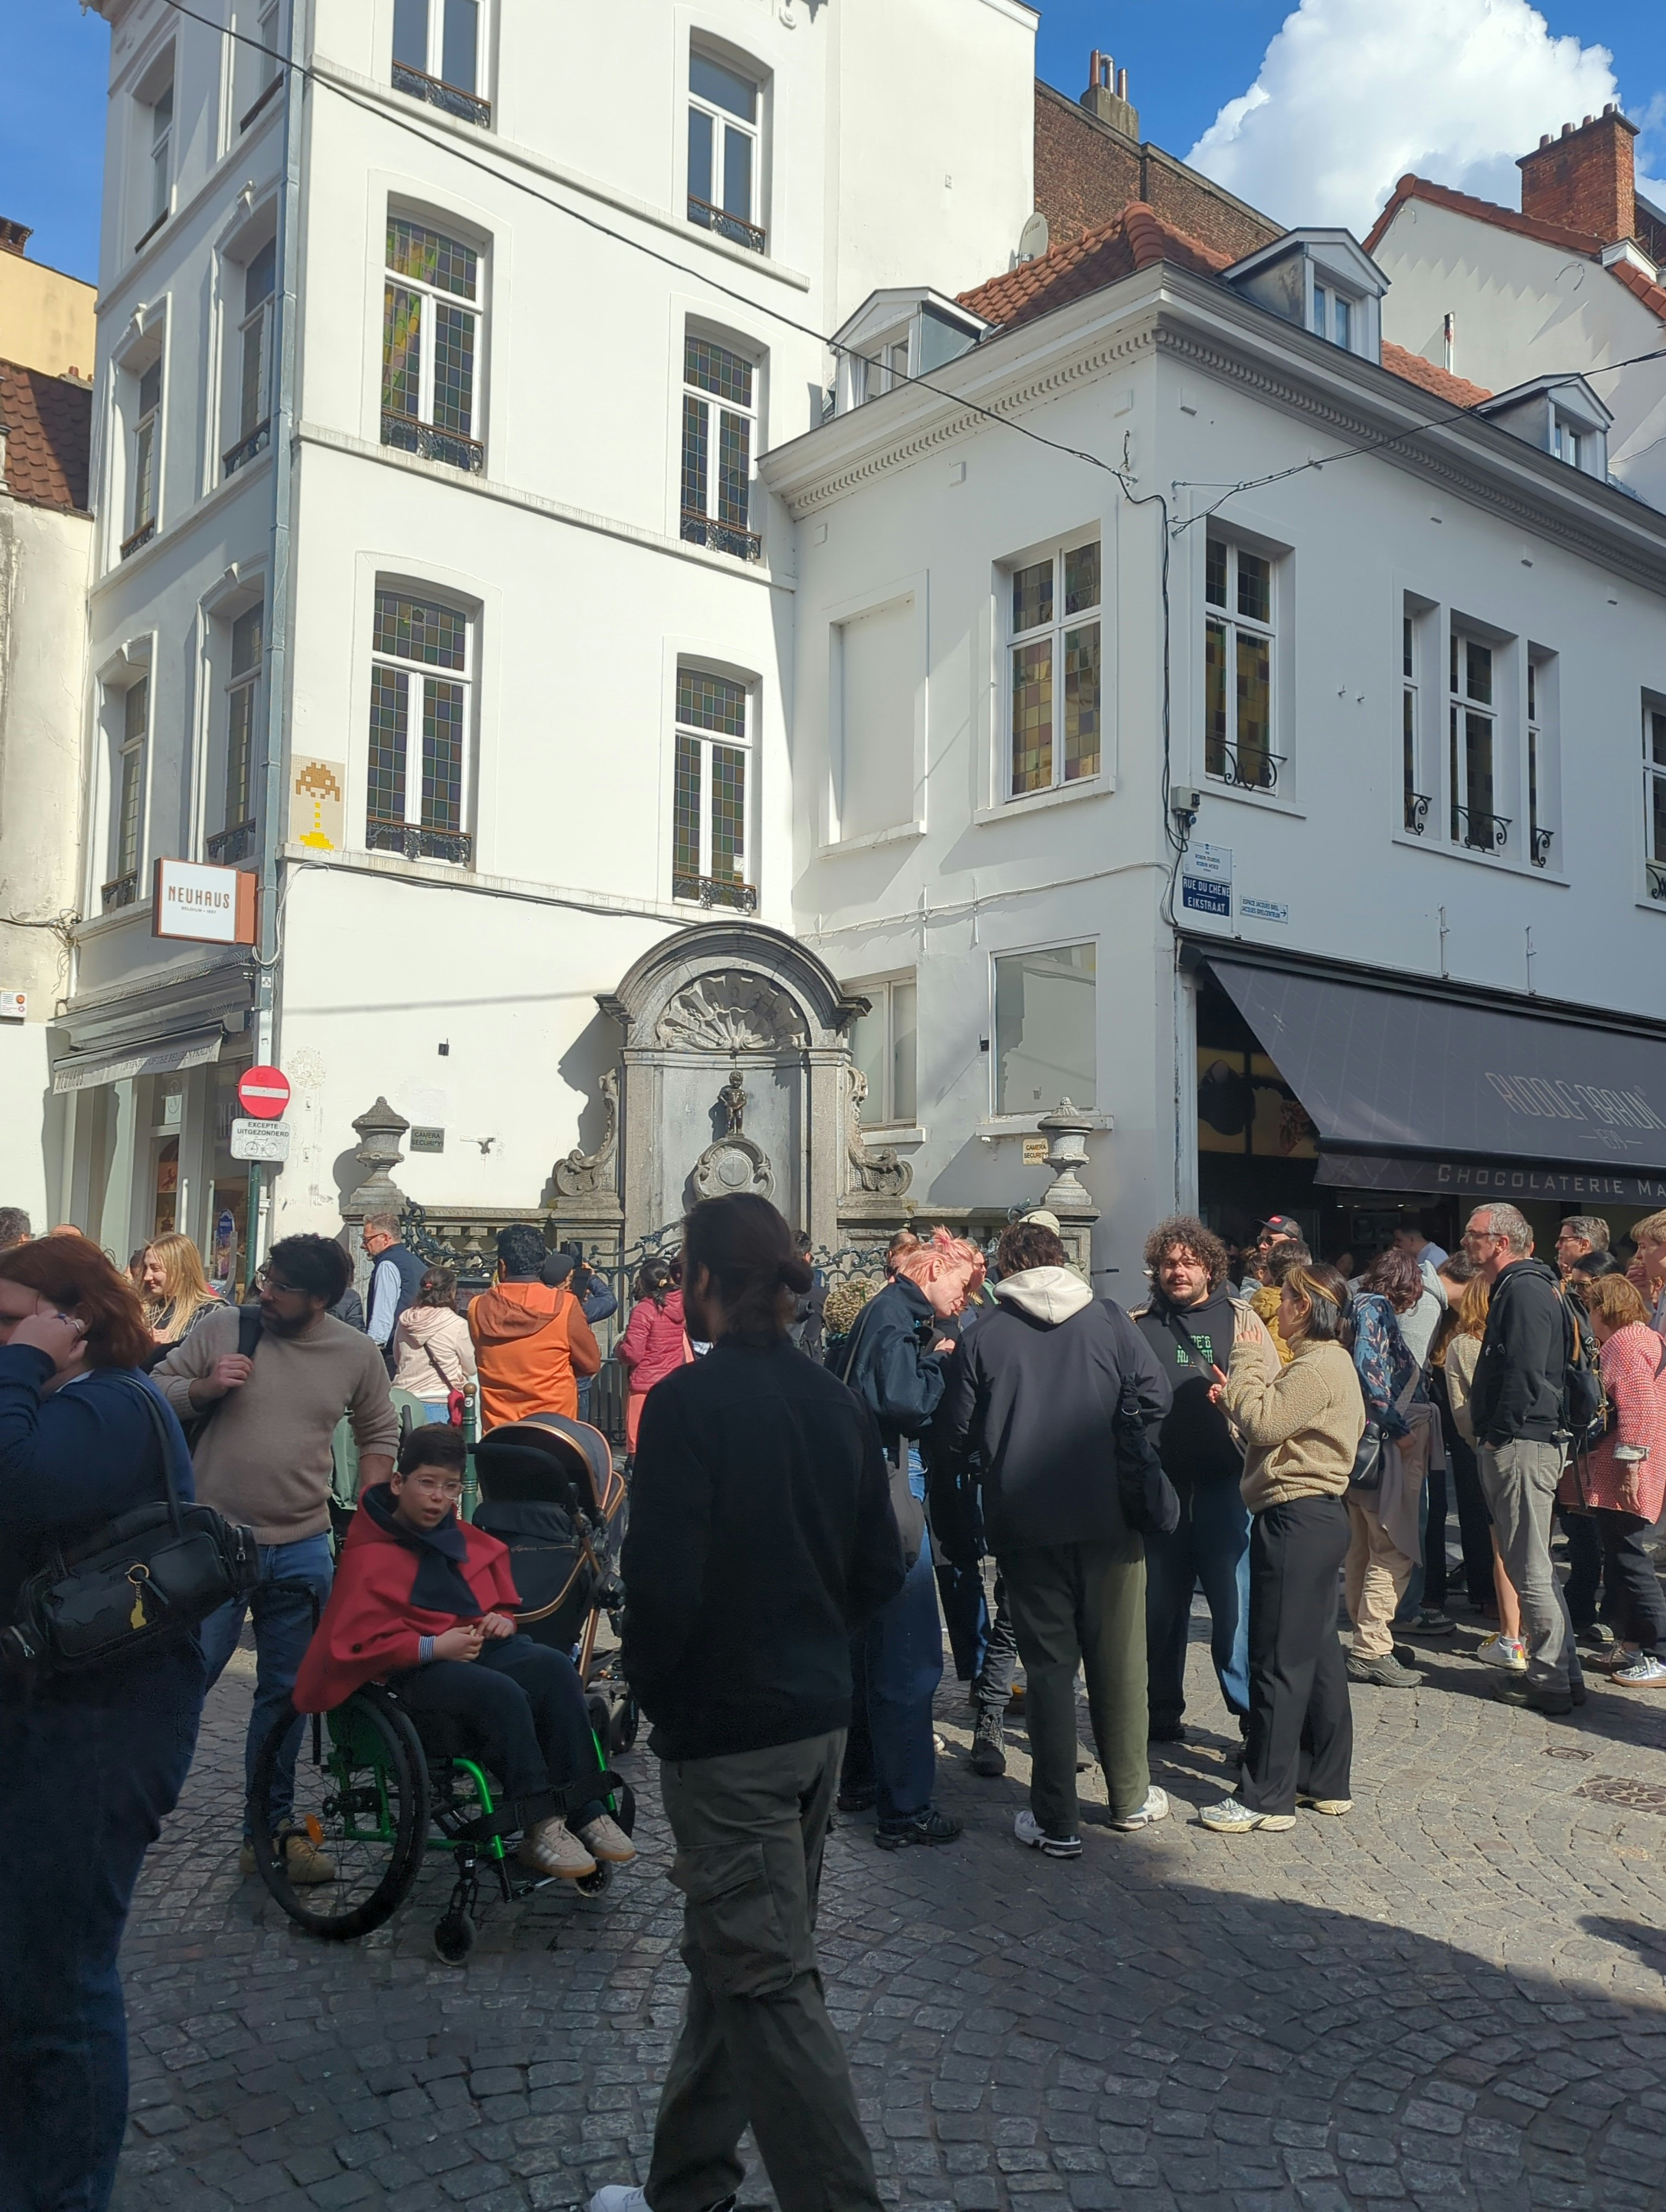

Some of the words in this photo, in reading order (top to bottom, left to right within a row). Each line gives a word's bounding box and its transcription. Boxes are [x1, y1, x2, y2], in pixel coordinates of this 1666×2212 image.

[1183, 878, 1197, 890] RUE
[1198, 882, 1208, 892] DU
[168, 885, 230, 909] NEUHAUS
[1188, 897, 1225, 913] EIKSTRAAT
[1485, 1072, 1588, 1121] RUDOLF
[1574, 1083, 1666, 1130] BRAUN
[237, 1129, 289, 1137] UITGEZONDERD
[1438, 1165, 1624, 1194] CHOCOLATERIE
